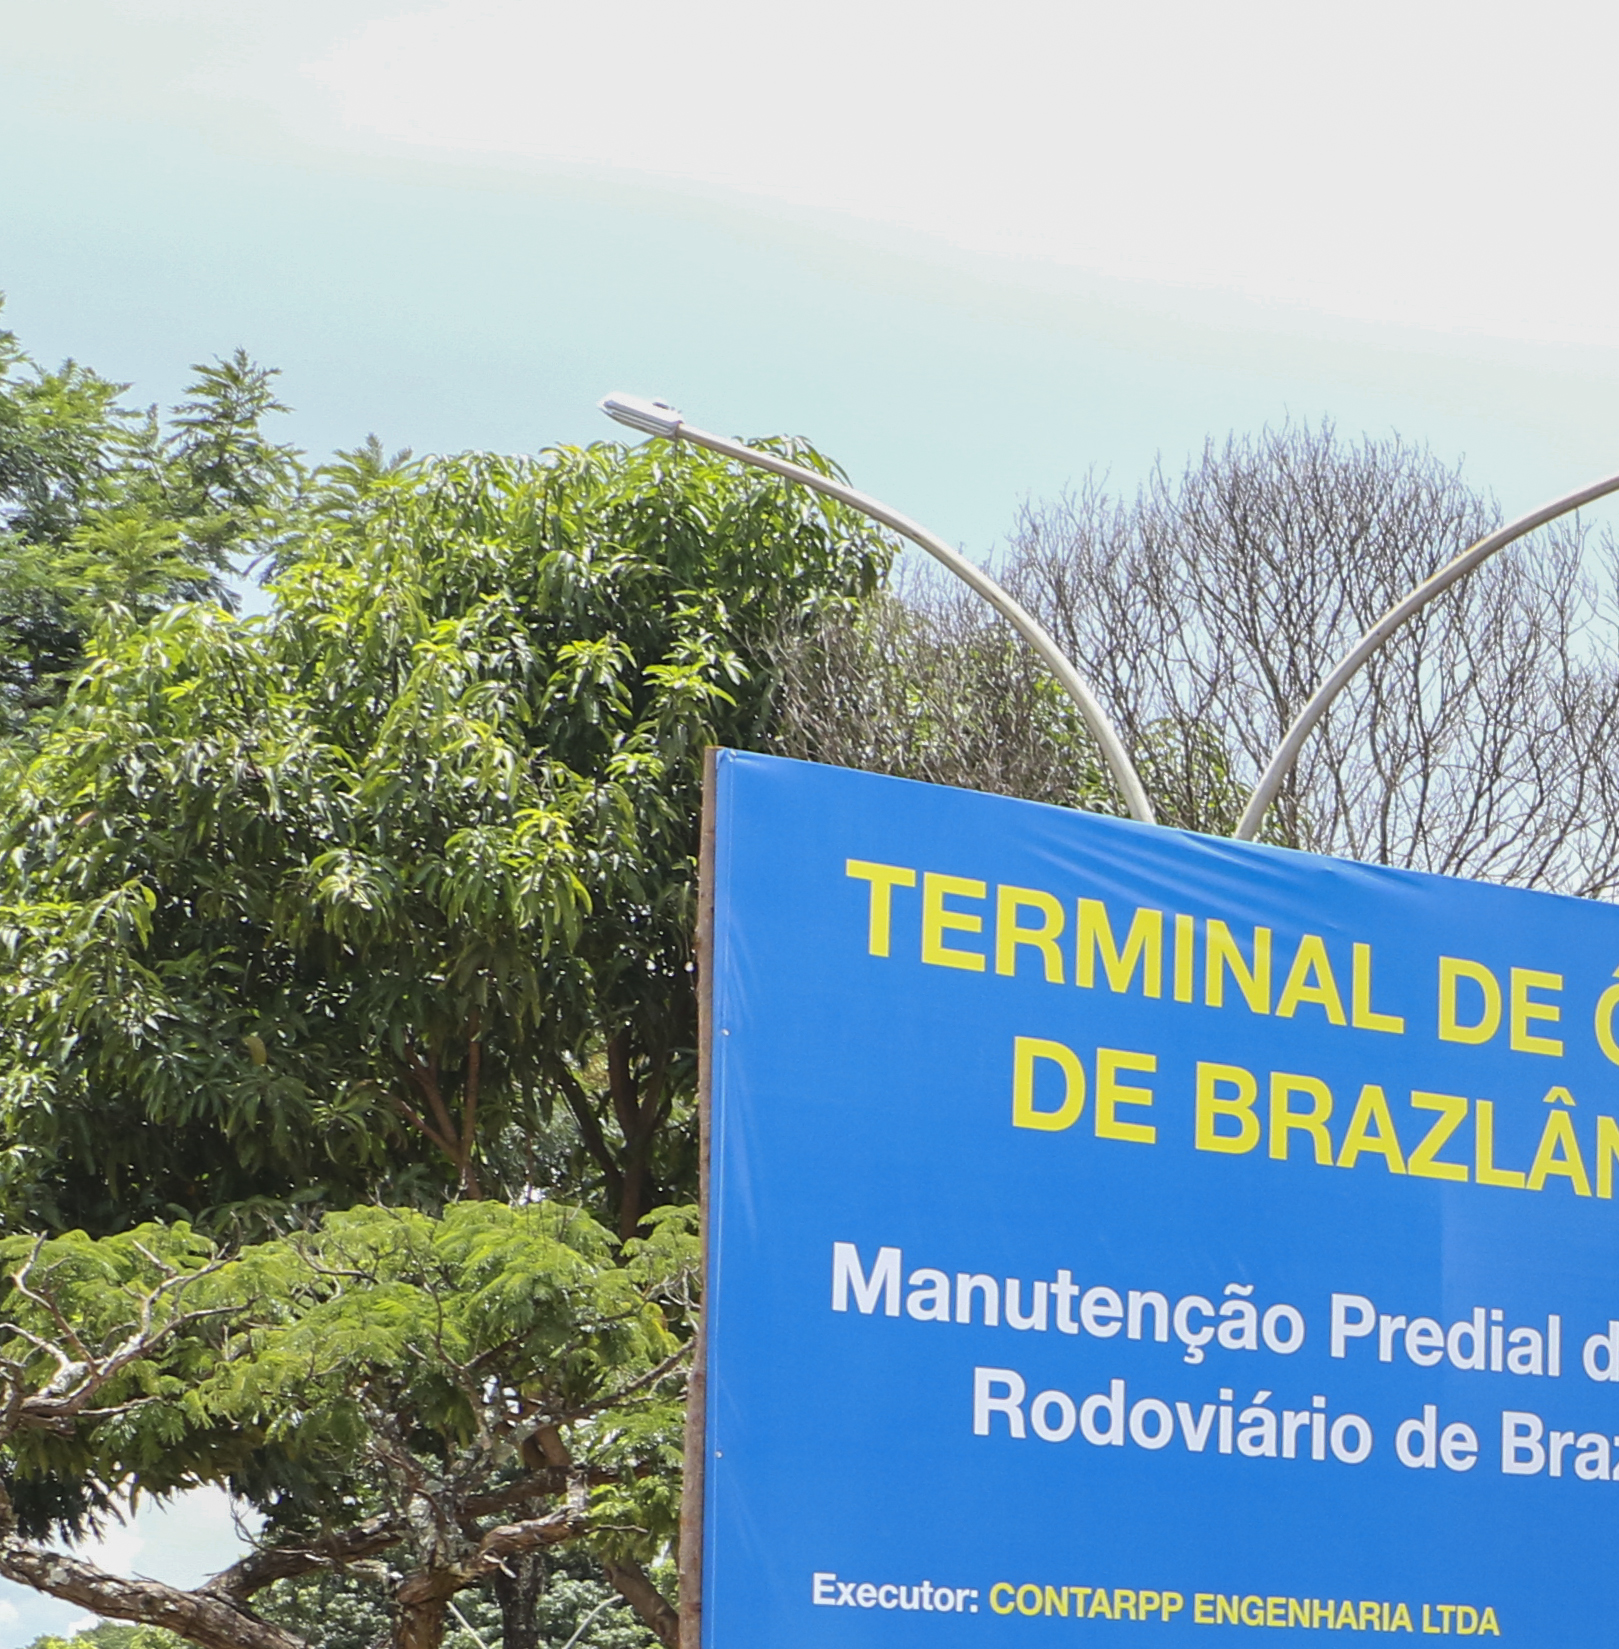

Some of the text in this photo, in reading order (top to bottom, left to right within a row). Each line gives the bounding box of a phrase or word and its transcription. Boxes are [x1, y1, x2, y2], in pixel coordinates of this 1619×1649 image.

[847, 860, 1405, 1036] TERMINAL
[1439, 957, 1565, 1058] DE
[1013, 1037, 1158, 1146] DE
[832, 1243, 1306, 1366] Manutenção
[1331, 1294, 1562, 1378] Predial
[974, 1367, 1374, 1465] Rodoviário
[1397, 1405, 1480, 1473] de
[813, 1573, 1502, 1637] Executor: CONTARPP ENGENHARIA LTDA
